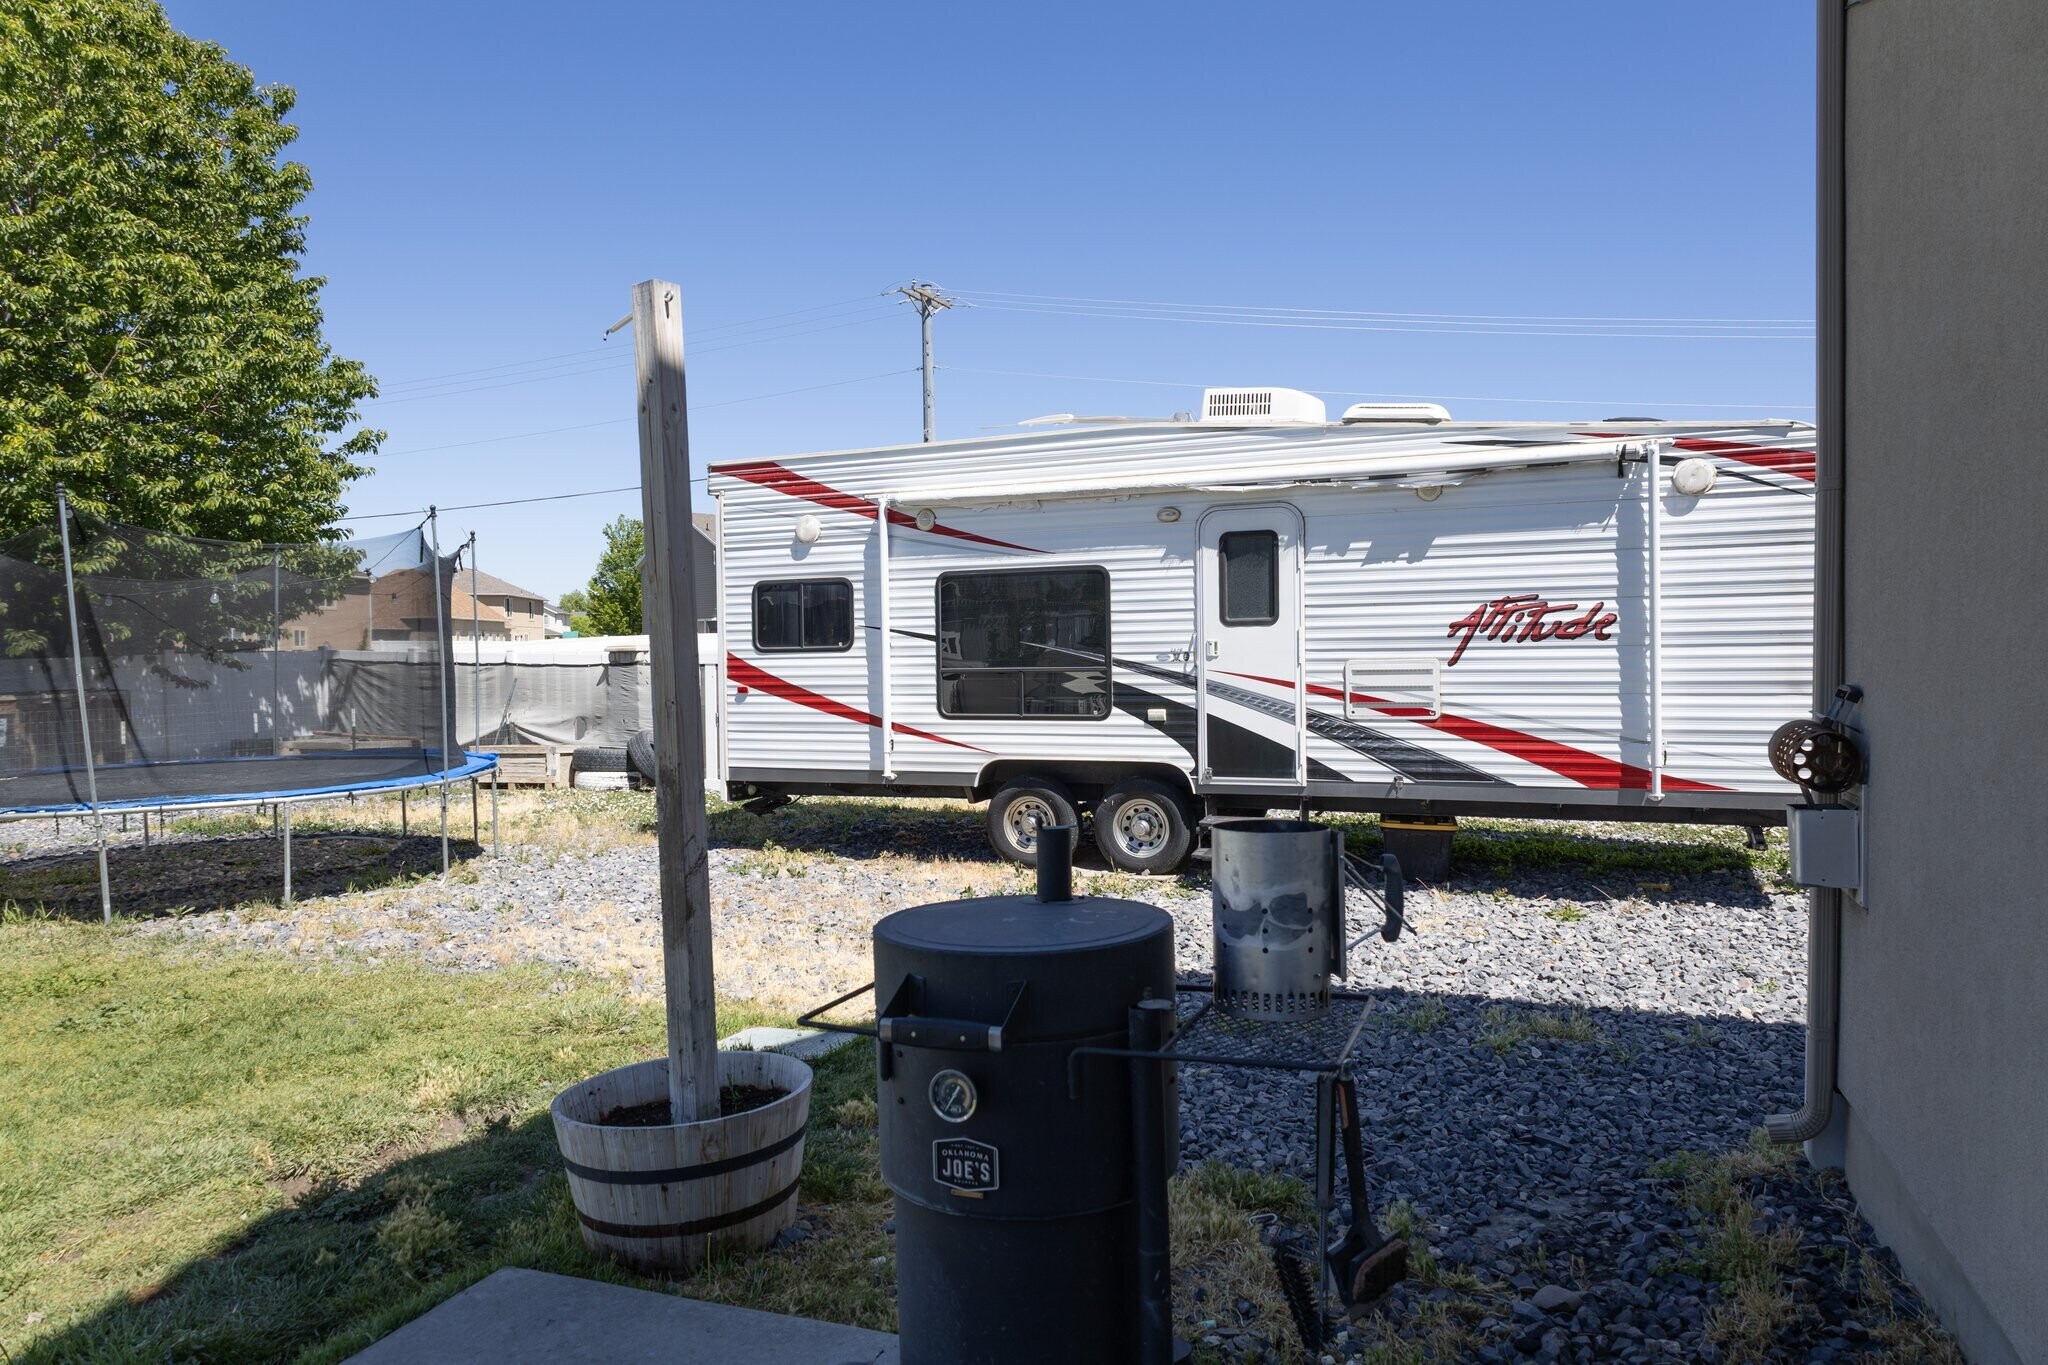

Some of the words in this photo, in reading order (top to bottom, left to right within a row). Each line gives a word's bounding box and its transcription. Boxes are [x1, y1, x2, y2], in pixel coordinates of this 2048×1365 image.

[1447, 594, 1617, 666] Attitude
[941, 1149, 989, 1161] OKLAHOMA
[942, 1158, 990, 1183] JOE'S
